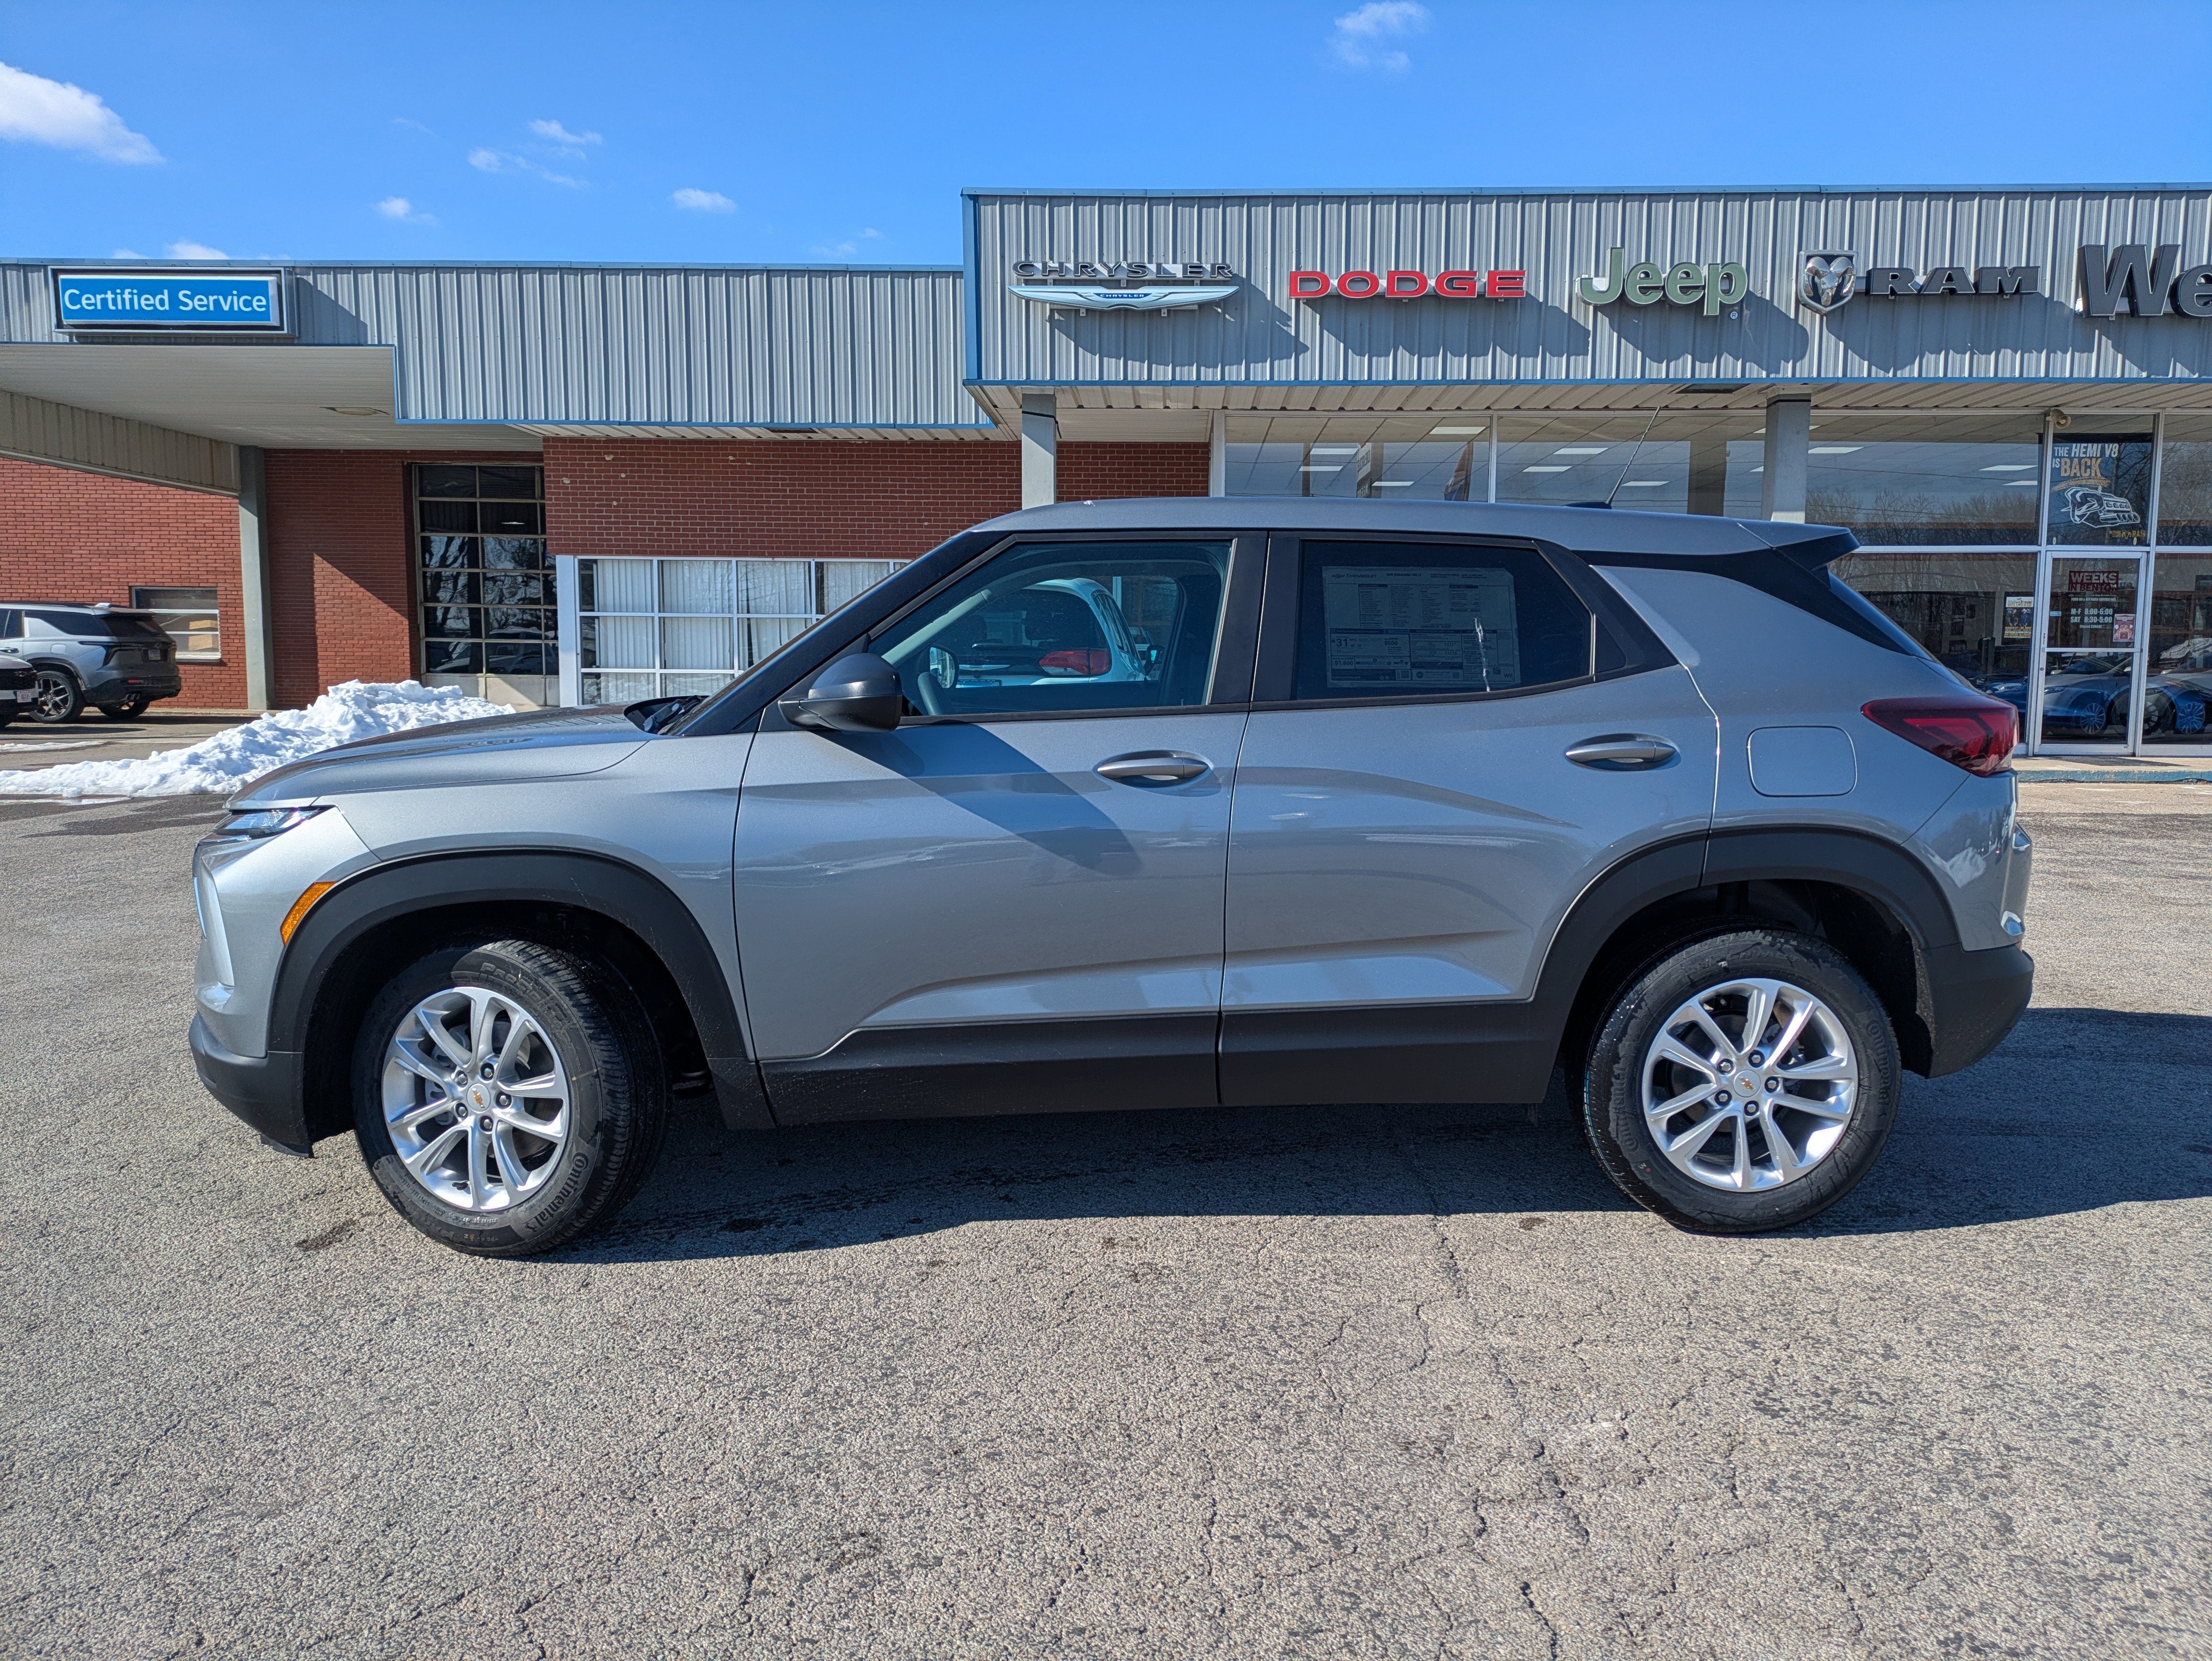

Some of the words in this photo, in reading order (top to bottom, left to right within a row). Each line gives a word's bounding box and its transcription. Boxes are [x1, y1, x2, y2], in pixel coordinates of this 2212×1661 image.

[1012, 260, 1233, 278] CHRYSLER
[1289, 269, 1527, 299] DODGE
[1576, 246, 1748, 316] Jeep
[1866, 266, 2041, 295] RAM
[63, 288, 169, 311] Certified
[178, 290, 267, 312] Service
[2054, 447, 2069, 457] THE
[2071, 443, 2102, 457] HEMI
[2105, 443, 2119, 457] V8
[2052, 458, 2060, 468] IS
[2060, 458, 2102, 477] BACK
[2070, 573, 2117, 583] WEEKS
[1336, 638, 1348, 647] 31
[533, 1152, 589, 1228] Continental
